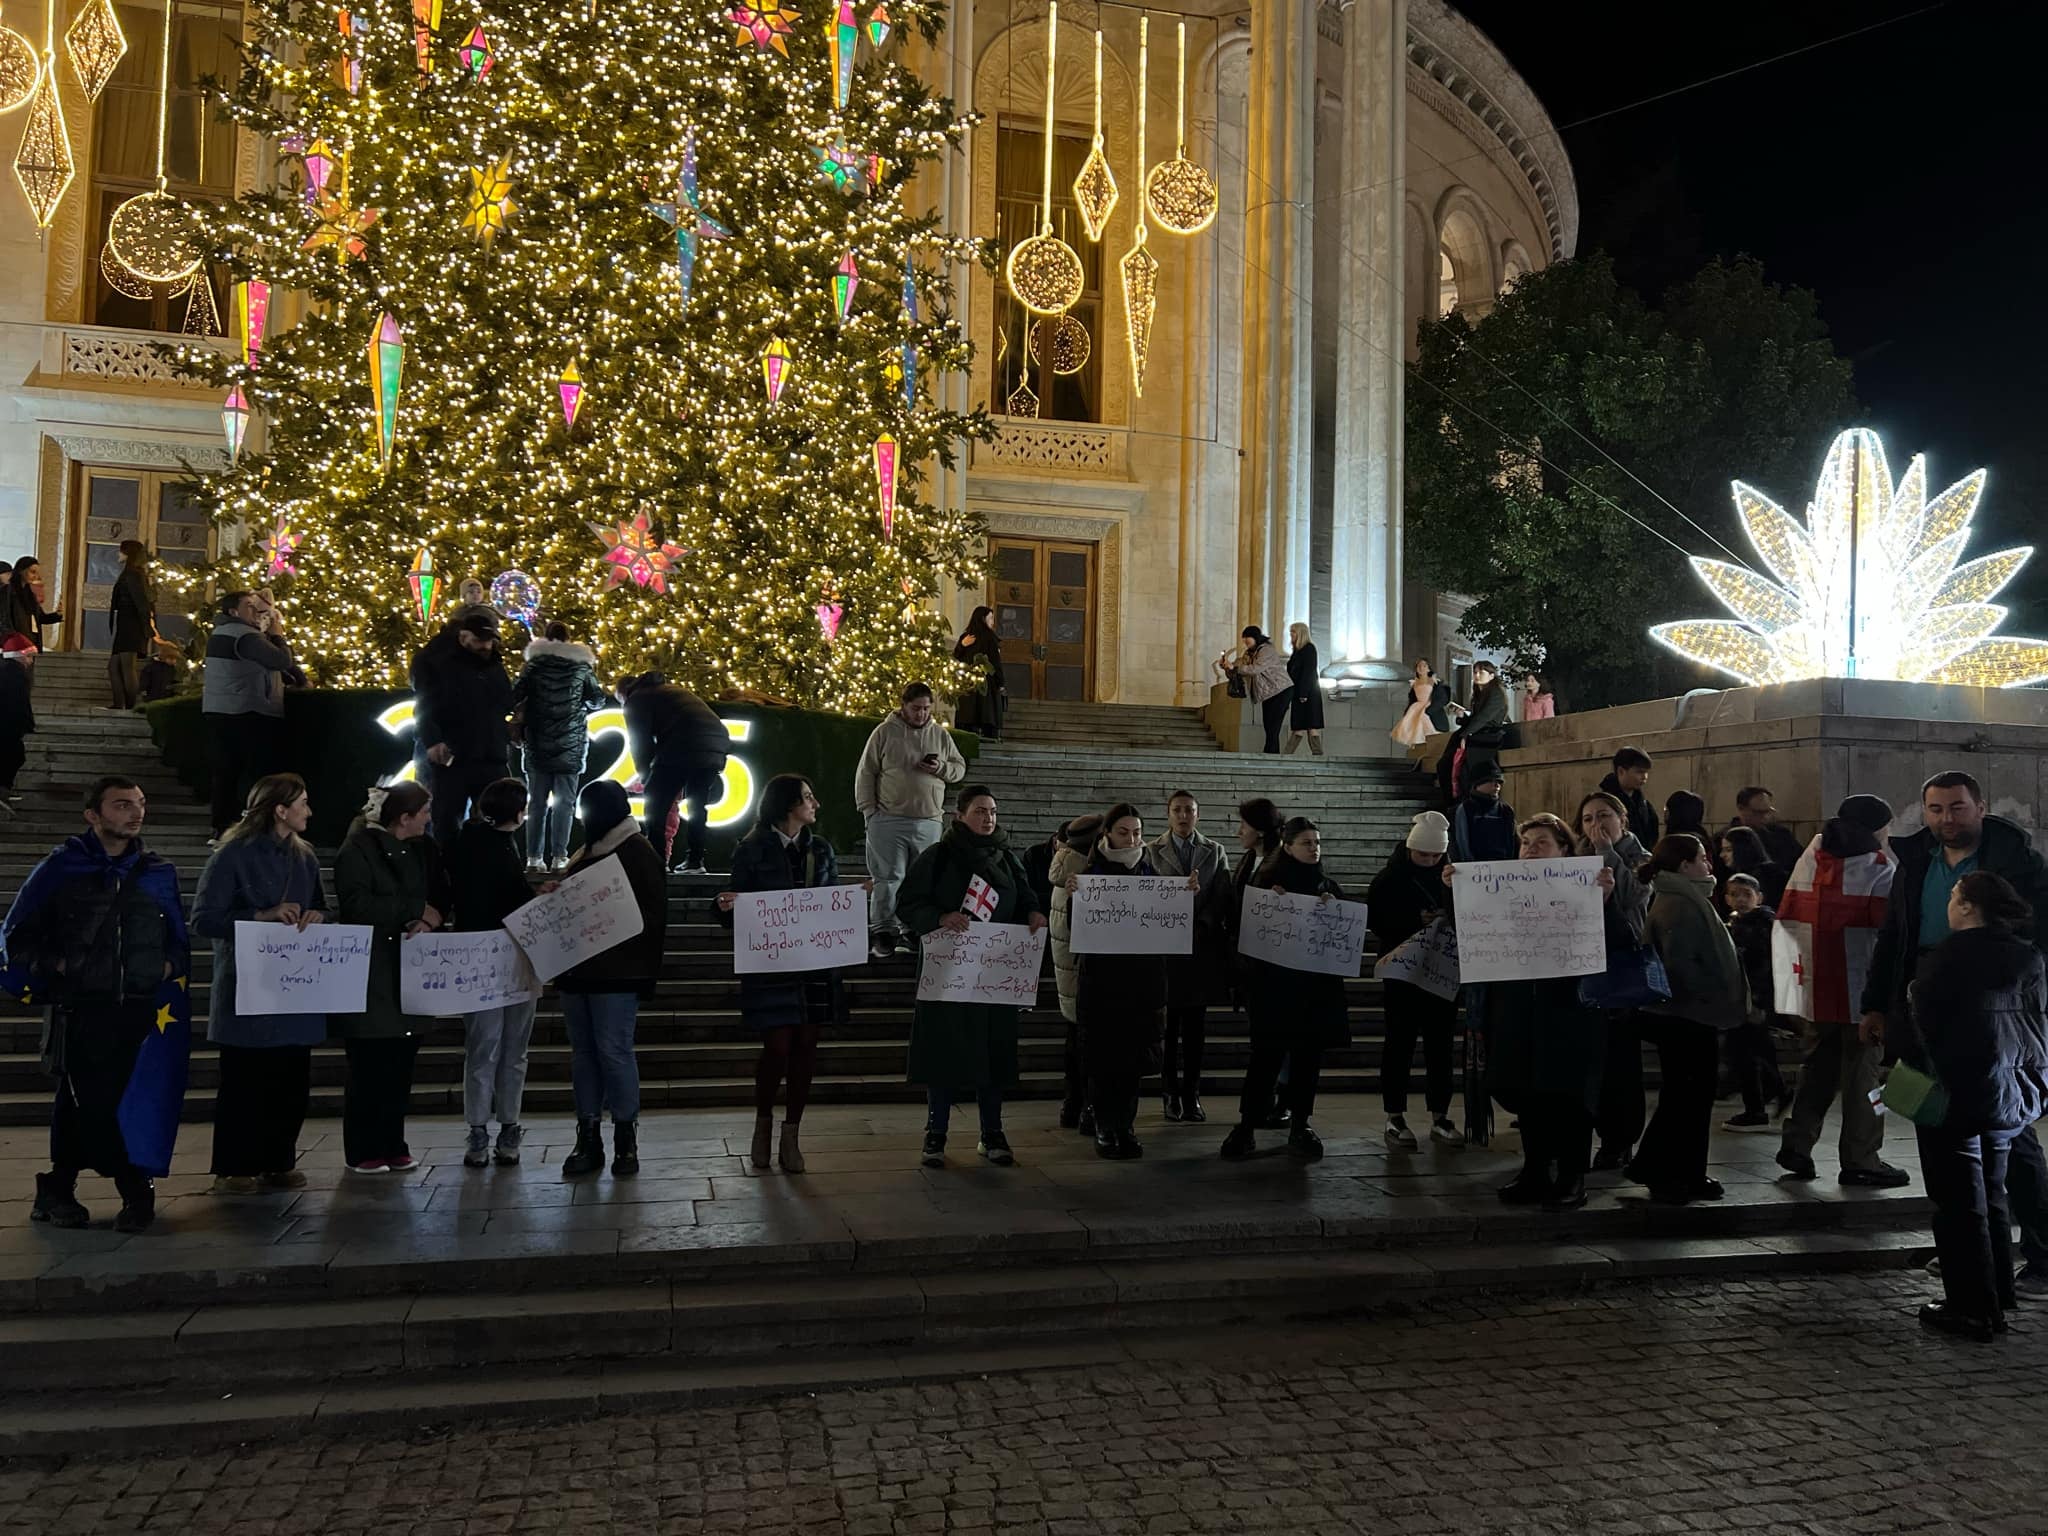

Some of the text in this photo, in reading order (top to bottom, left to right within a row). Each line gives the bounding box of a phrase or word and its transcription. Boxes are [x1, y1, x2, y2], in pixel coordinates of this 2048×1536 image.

[756, 890, 855, 928] შევქმენით 85
[257, 936, 301, 961] ახალი
[748, 927, 856, 960] სამუშაო ადგილი
